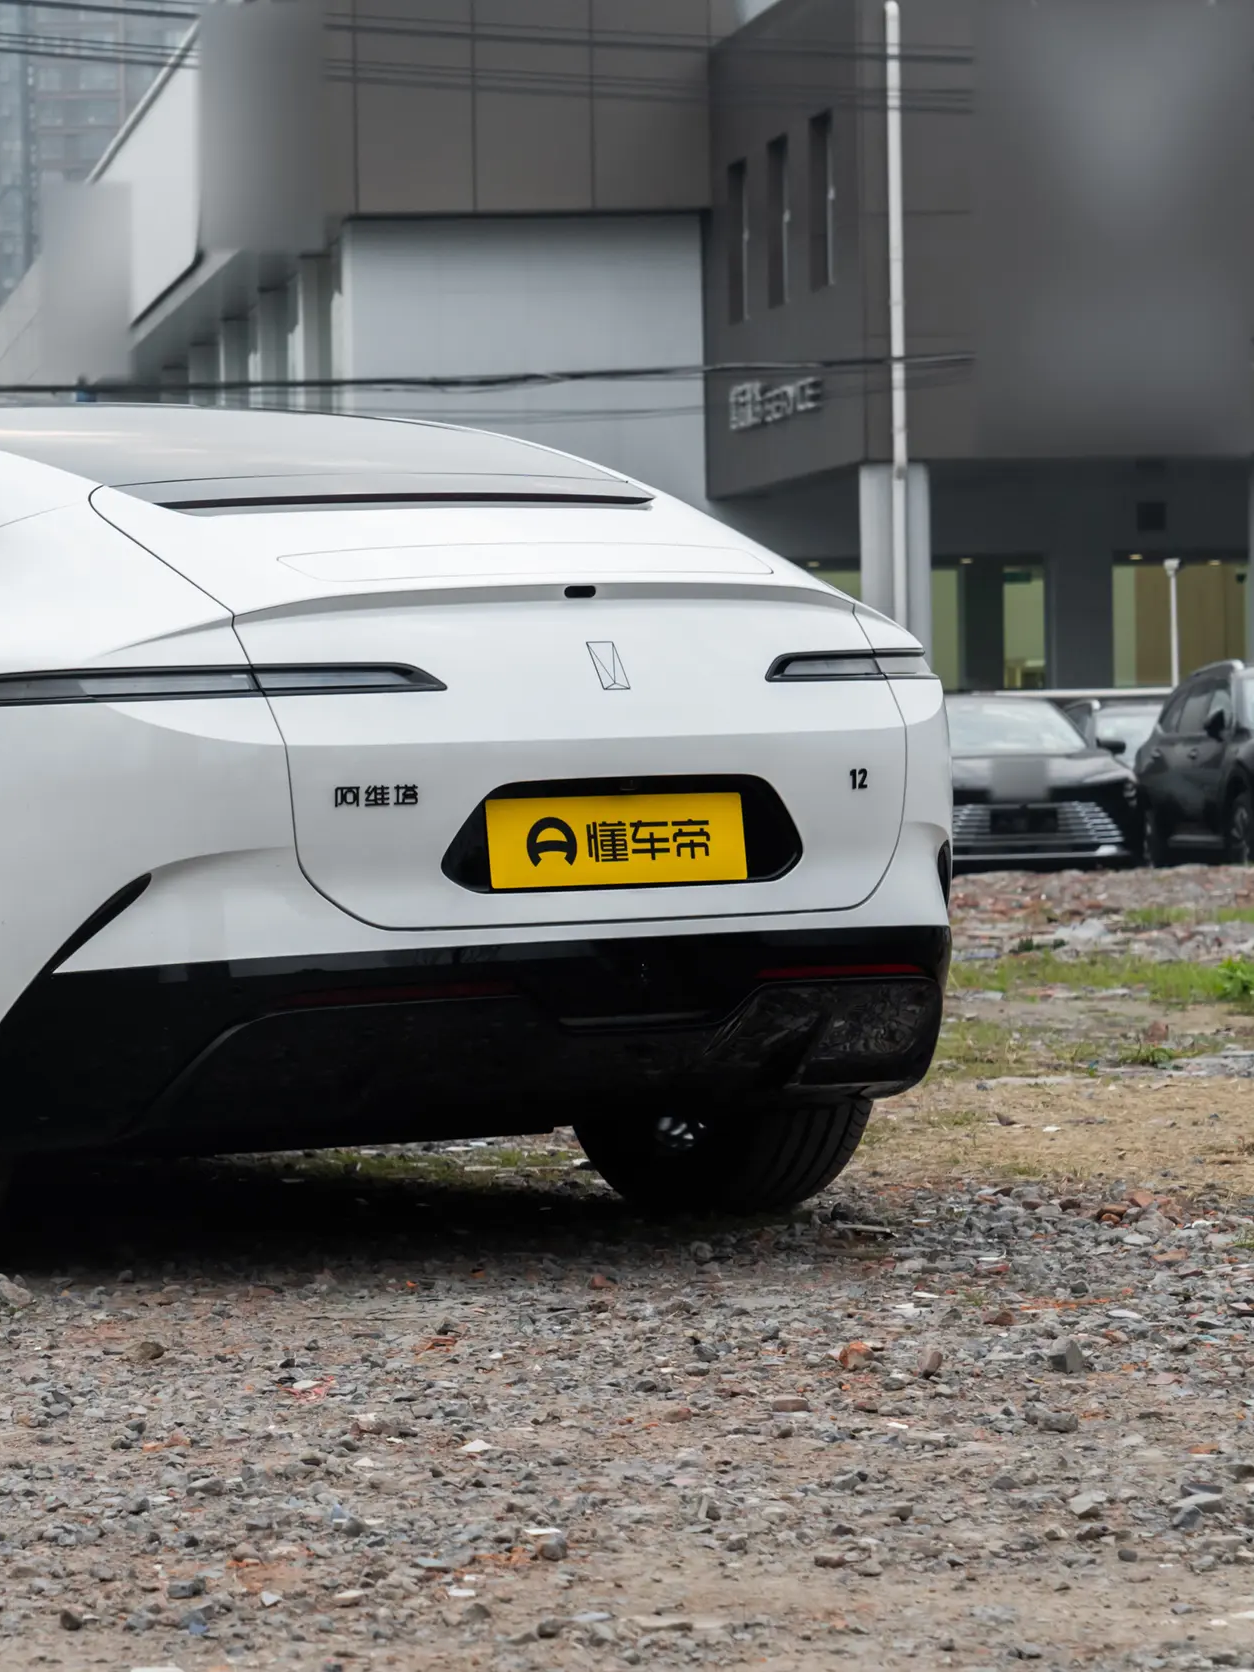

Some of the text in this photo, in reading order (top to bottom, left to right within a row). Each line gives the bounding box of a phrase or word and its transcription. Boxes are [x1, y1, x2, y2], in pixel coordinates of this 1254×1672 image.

[849, 768, 868, 790] 12
[334, 784, 419, 808] 阿维塔
[586, 818, 711, 863] 懂车帝
